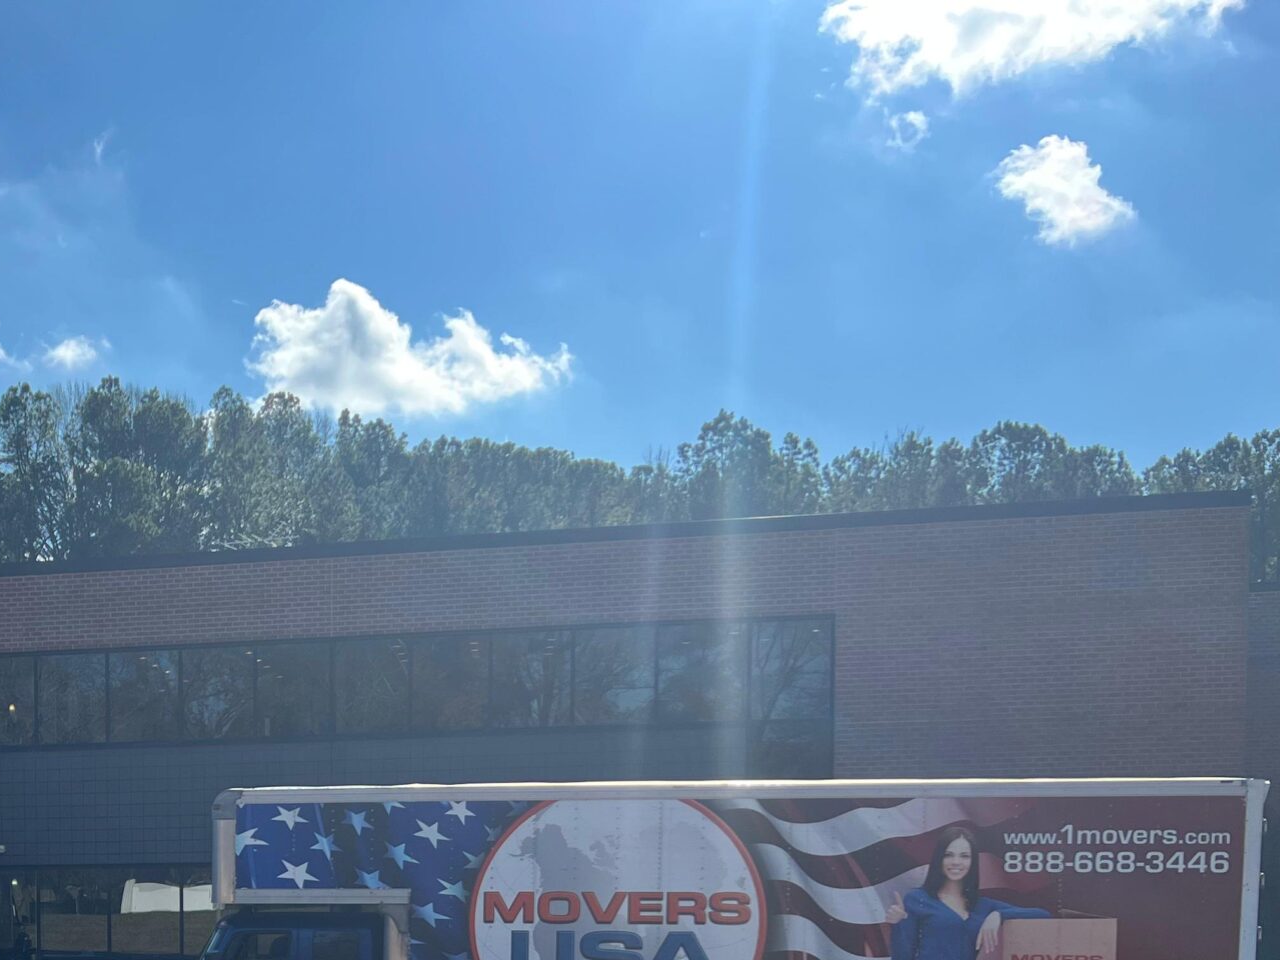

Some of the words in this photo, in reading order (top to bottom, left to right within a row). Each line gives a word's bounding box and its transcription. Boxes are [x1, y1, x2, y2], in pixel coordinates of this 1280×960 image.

[1004, 824, 1231, 845] www.1movers.com
[1003, 851, 1230, 873] 888-668-3446
[483, 890, 752, 925] MOVERS
